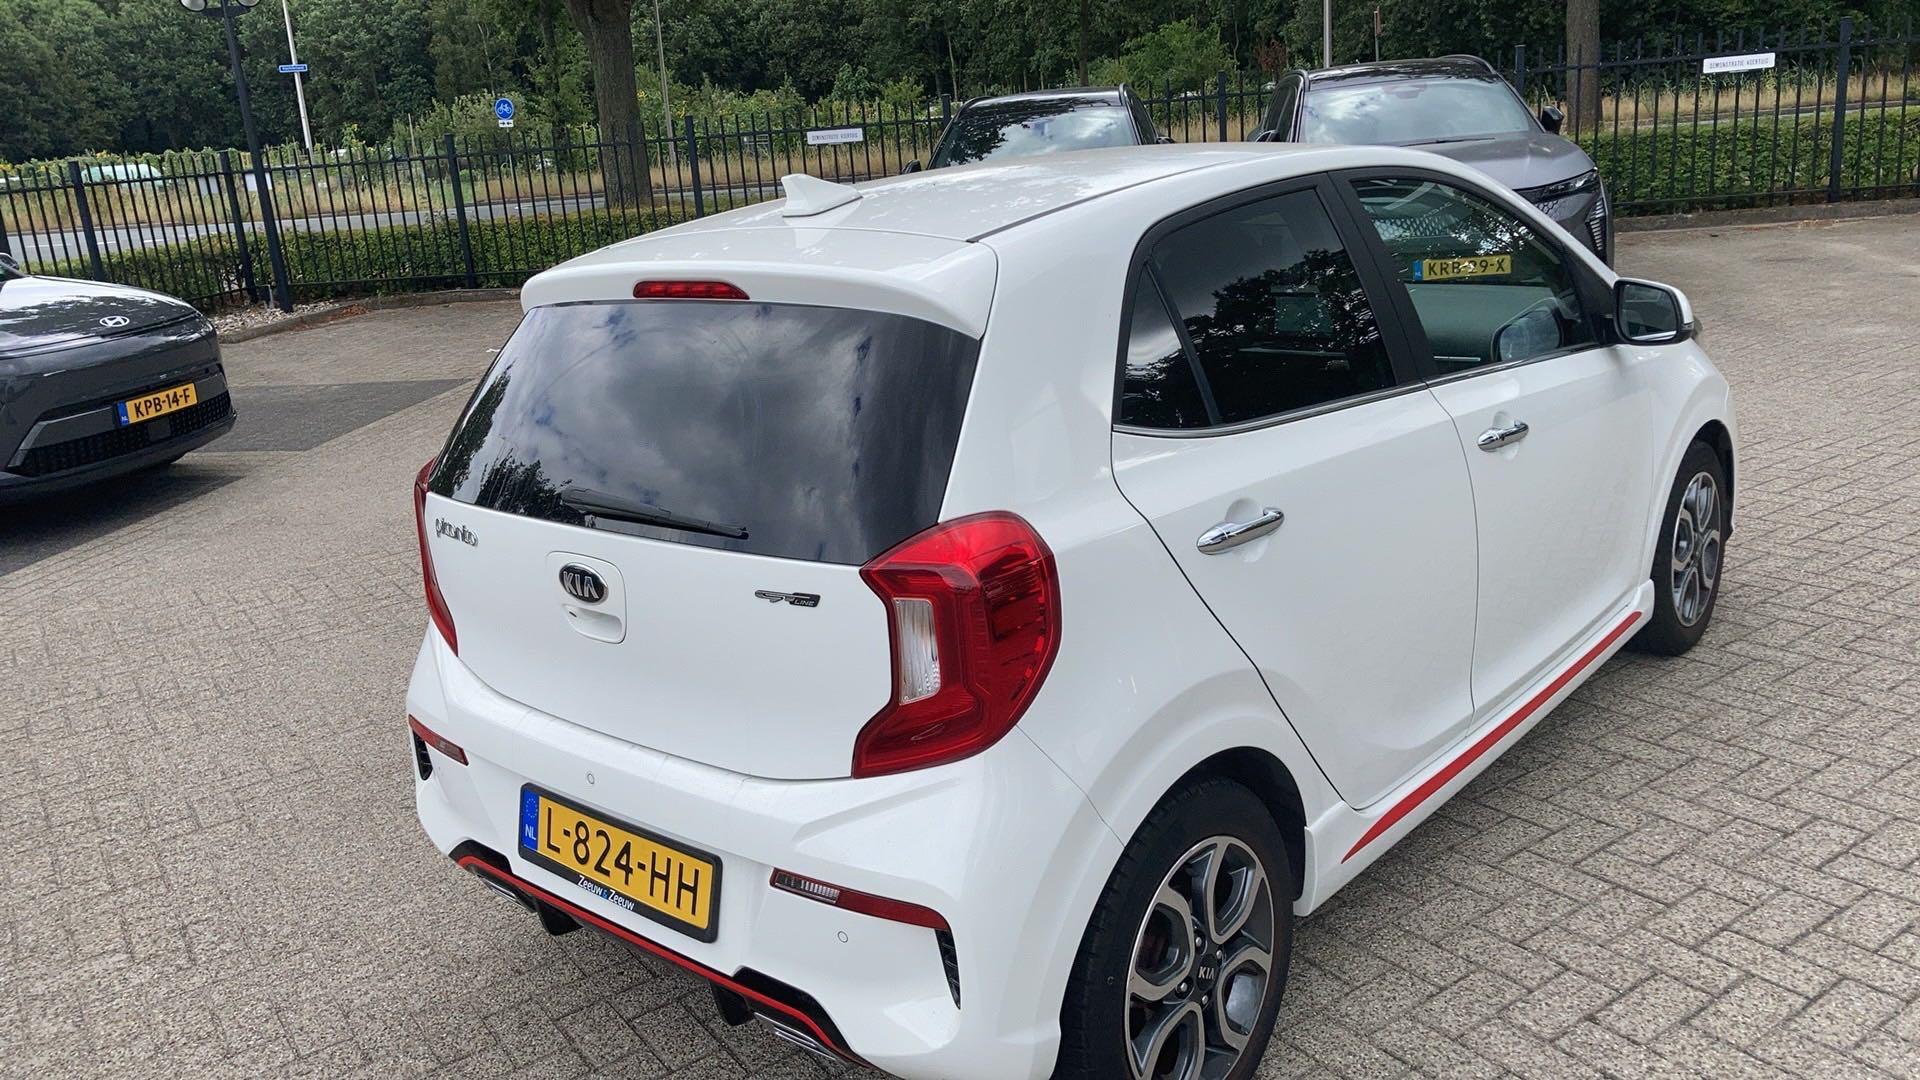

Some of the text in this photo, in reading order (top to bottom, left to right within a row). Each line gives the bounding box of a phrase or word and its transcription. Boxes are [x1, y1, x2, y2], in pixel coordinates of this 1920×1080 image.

[134, 388, 190, 418] KPB-14-F
[563, 571, 600, 599] KIA
[525, 823, 537, 841] NL
[546, 807, 700, 916] L-824-HH
[577, 874, 602, 896] Zeeuw
[608, 889, 635, 911] Zeeuw
[1198, 966, 1215, 980] KIA
